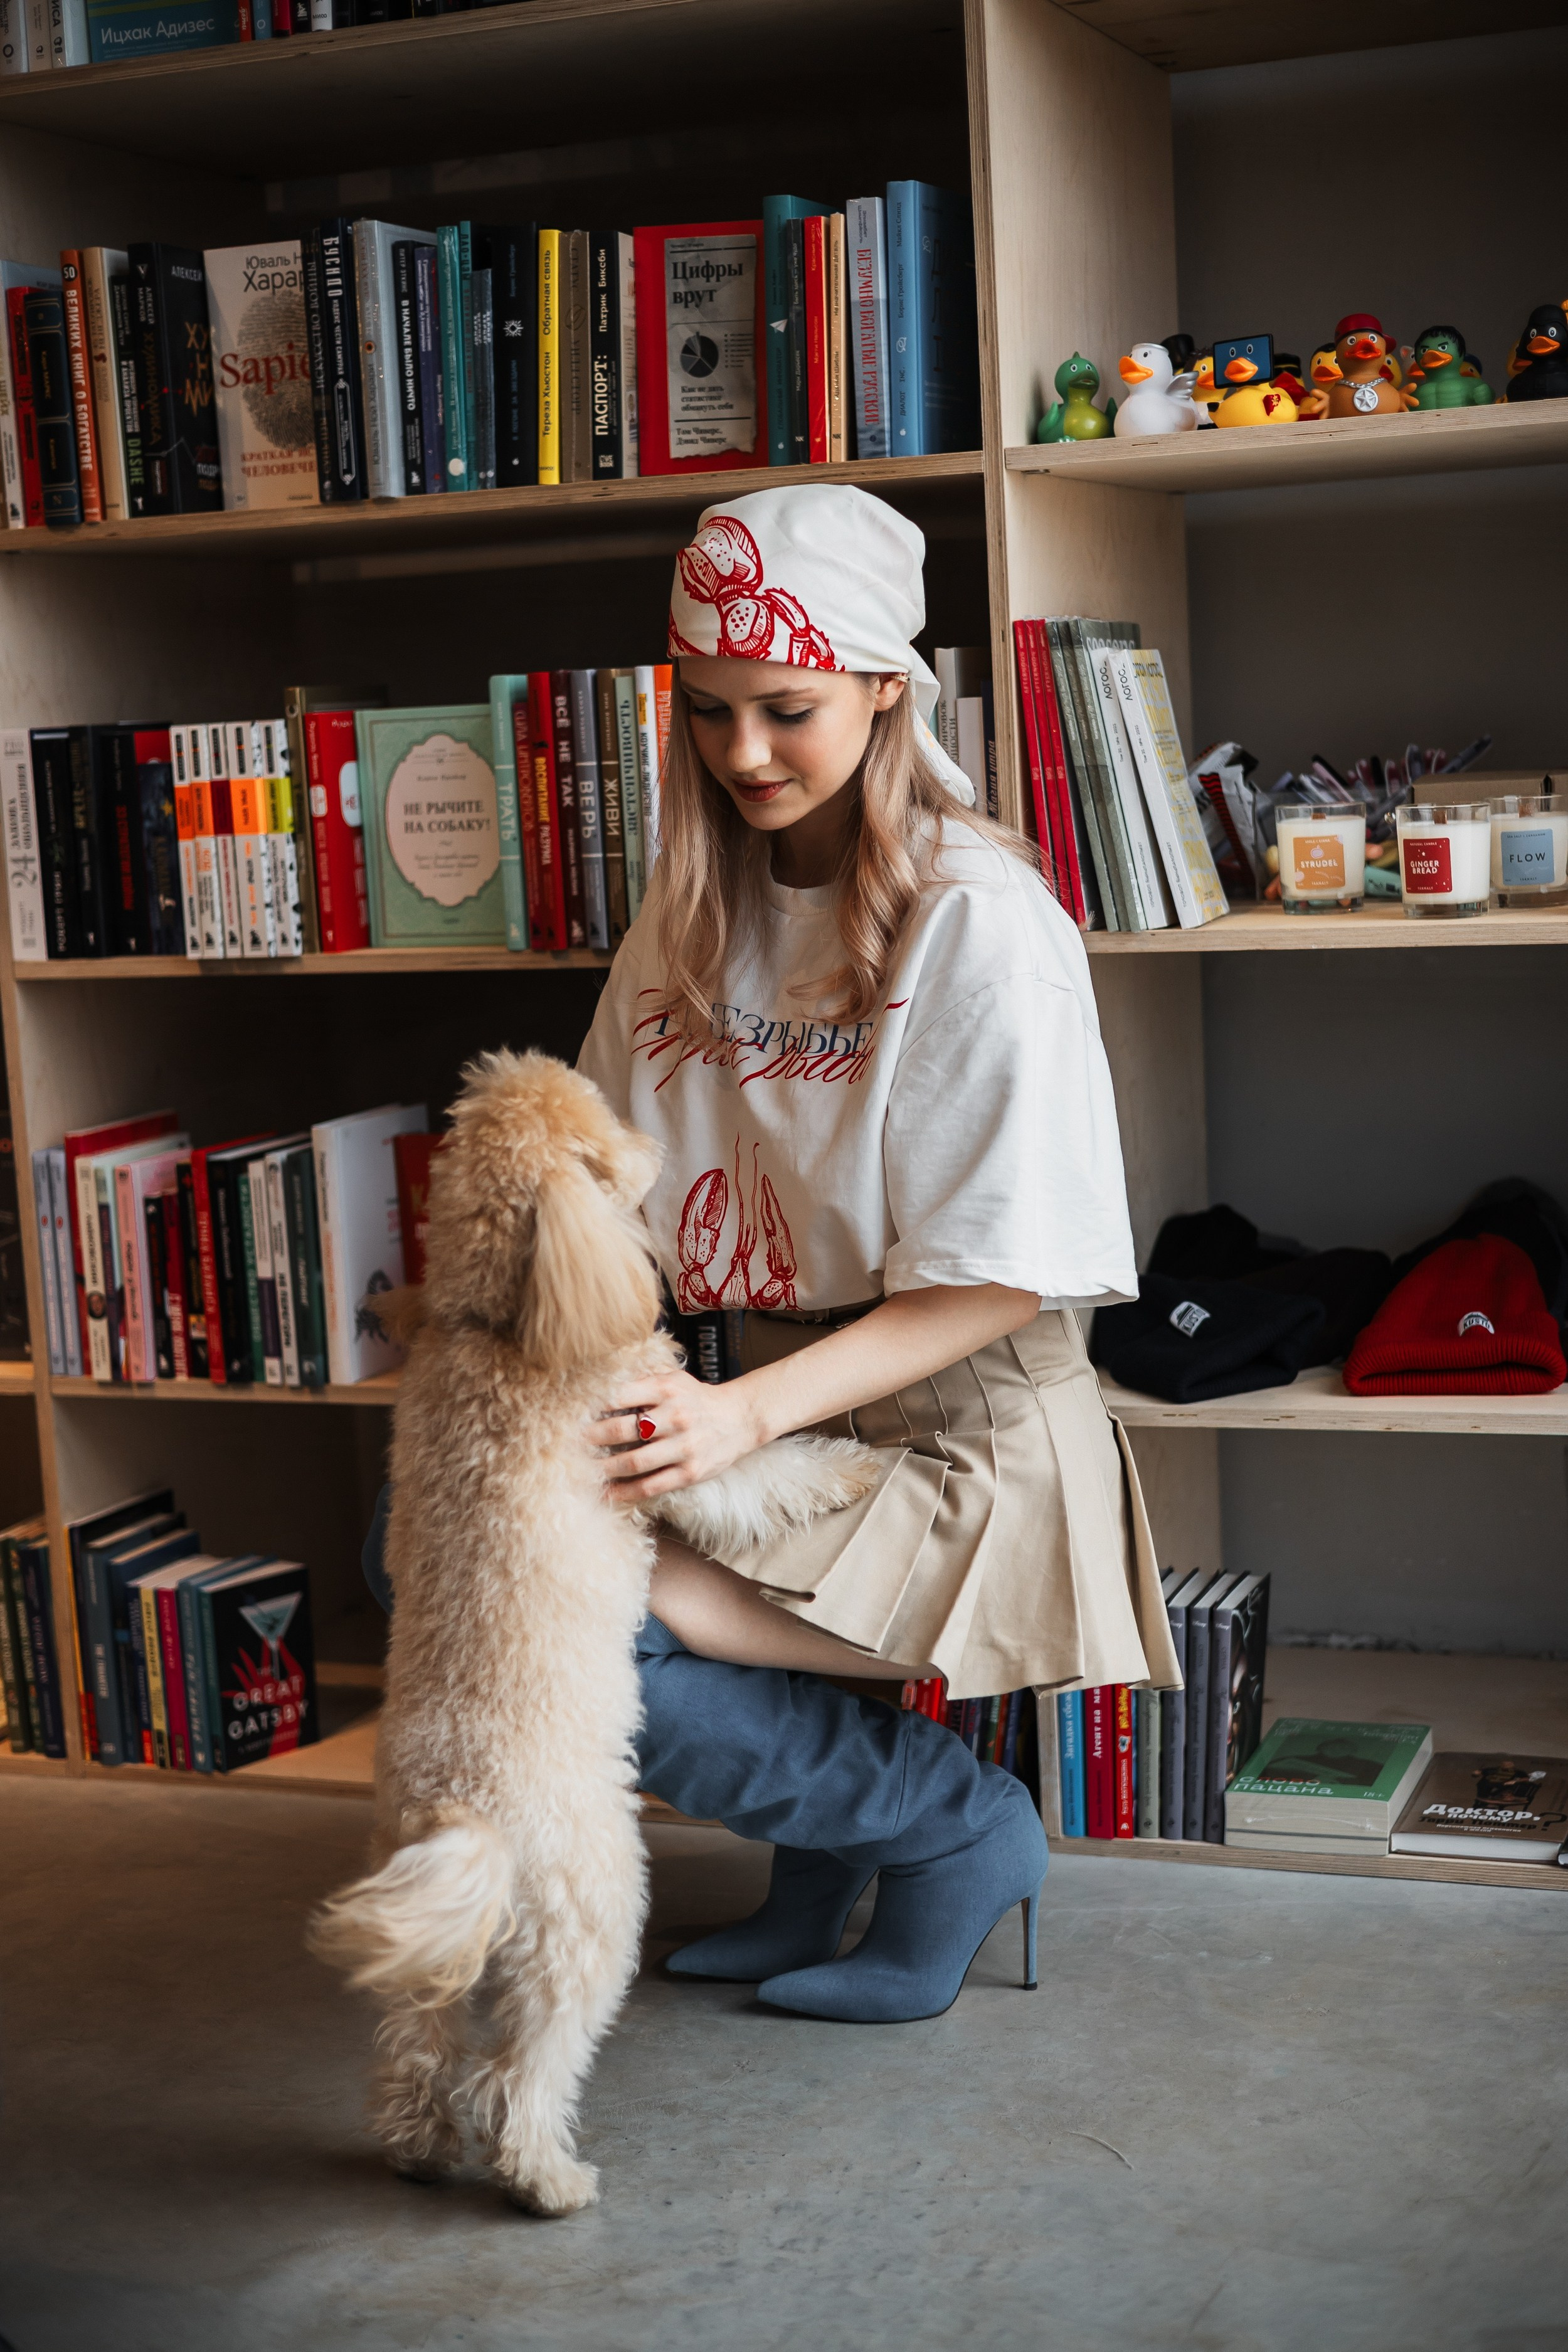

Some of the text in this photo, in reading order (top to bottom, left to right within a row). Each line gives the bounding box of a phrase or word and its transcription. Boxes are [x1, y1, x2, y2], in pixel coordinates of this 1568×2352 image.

[100, 17, 215, 45] Ицхак Адизес
[246, 256, 290, 270] Юваль
[322, 236, 343, 297] БУСИДО
[399, 270, 408, 293] ЭТКИНС
[672, 260, 743, 283] Цифры
[137, 287, 146, 322] МАРКОВ
[145, 287, 155, 324] АЛЕКСЕЙ
[543, 249, 552, 336] Обратная связь
[598, 248, 607, 332] Патрик Биксби
[673, 289, 717, 308] врут
[306, 262, 326, 389] ИСКУССТВО ВОЙНЫ
[332, 300, 341, 324] КОДЕКС
[401, 309, 412, 346] НАЧАЛЕ
[334, 326, 342, 344] ЧЕСТИ
[856, 248, 879, 426] БЕЗУМНО БОГАТЫЕ РУССКИЕ
[63, 265, 92, 472] 50 ВЕЛИКИХ КНИГ О БОГАТСТВЕ
[404, 348, 413, 376] БЫЛО
[142, 331, 162, 445] ХУЛИНОМИКА
[406, 379, 416, 411] НИЧТО
[543, 351, 551, 438] Тереза Хьюстон
[595, 354, 610, 436] ПАСПОРТ:
[127, 438, 144, 485] DASHE
[554, 695, 574, 807] ВСЁ НЕ ТАК
[620, 699, 638, 836] ЗАСТЕНЧИВОСТЬ
[987, 739, 999, 818] Магия утра
[403, 800, 483, 815] НЕ РЫЧИТЕ
[498, 782, 516, 842] ТРАТЬ
[534, 756, 552, 866] ВОСПИТАНИЕ РАЗУМА
[578, 780, 597, 839] ВЕРЬ
[603, 778, 620, 836] ЖИВИ
[403, 818, 490, 834] НА СОБАКУ!
[1300, 859, 1338, 869] STRUDEL
[1410, 860, 1439, 868] GINGER
[1509, 852, 1545, 863] FLOW
[1177, 884, 1187, 908] ПОВОРОТ
[1463, 1318, 1490, 1330] KUSTO
[232, 1674, 302, 1712] GREAT
[227, 1699, 309, 1740] GATSBY
[1092, 1709, 1102, 1759] Агент на
[1064, 1720, 1074, 1759] Загадка
[1234, 1783, 1334, 1796] пацана
[1239, 1776, 1321, 1786] слово
[1419, 1816, 1463, 1825] Гарри
[1471, 1818, 1537, 1830] Поттер
[1422, 1803, 1540, 1821] Доктор,
[1448, 1813, 1512, 1823] почему
